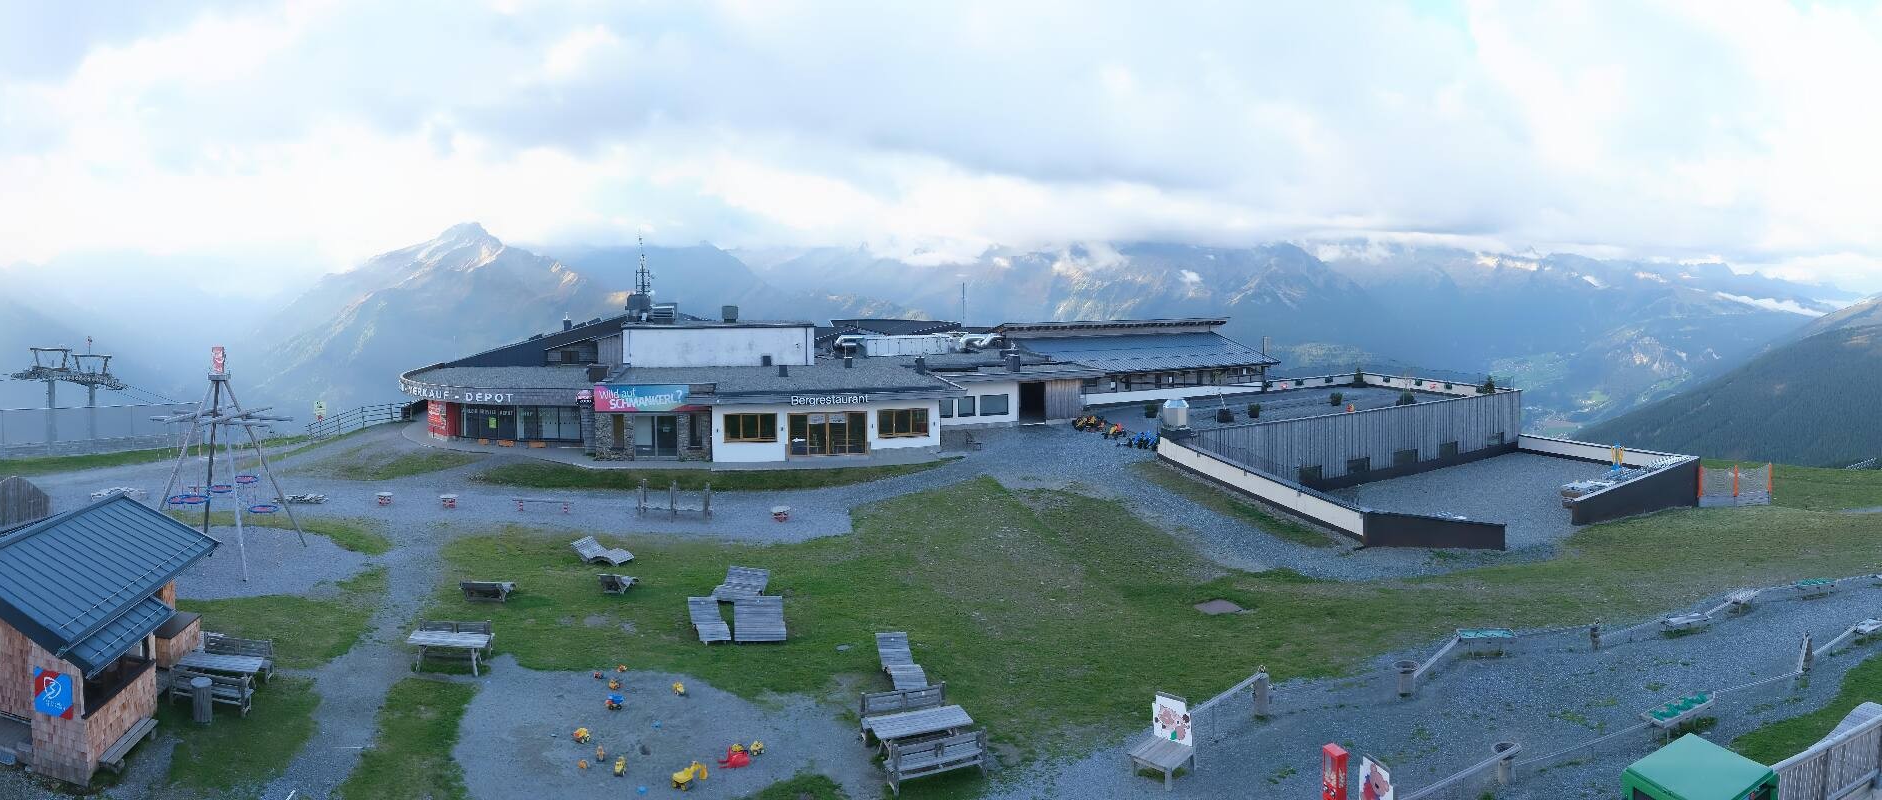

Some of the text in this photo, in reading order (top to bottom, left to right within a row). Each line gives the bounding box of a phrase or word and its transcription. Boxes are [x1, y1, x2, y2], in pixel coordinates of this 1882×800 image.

[465, 392, 515, 403] DEPOT
[598, 388, 620, 400] Wild
[609, 389, 684, 410] SCHMANKERL?
[790, 393, 870, 407] Bergrestaurant
